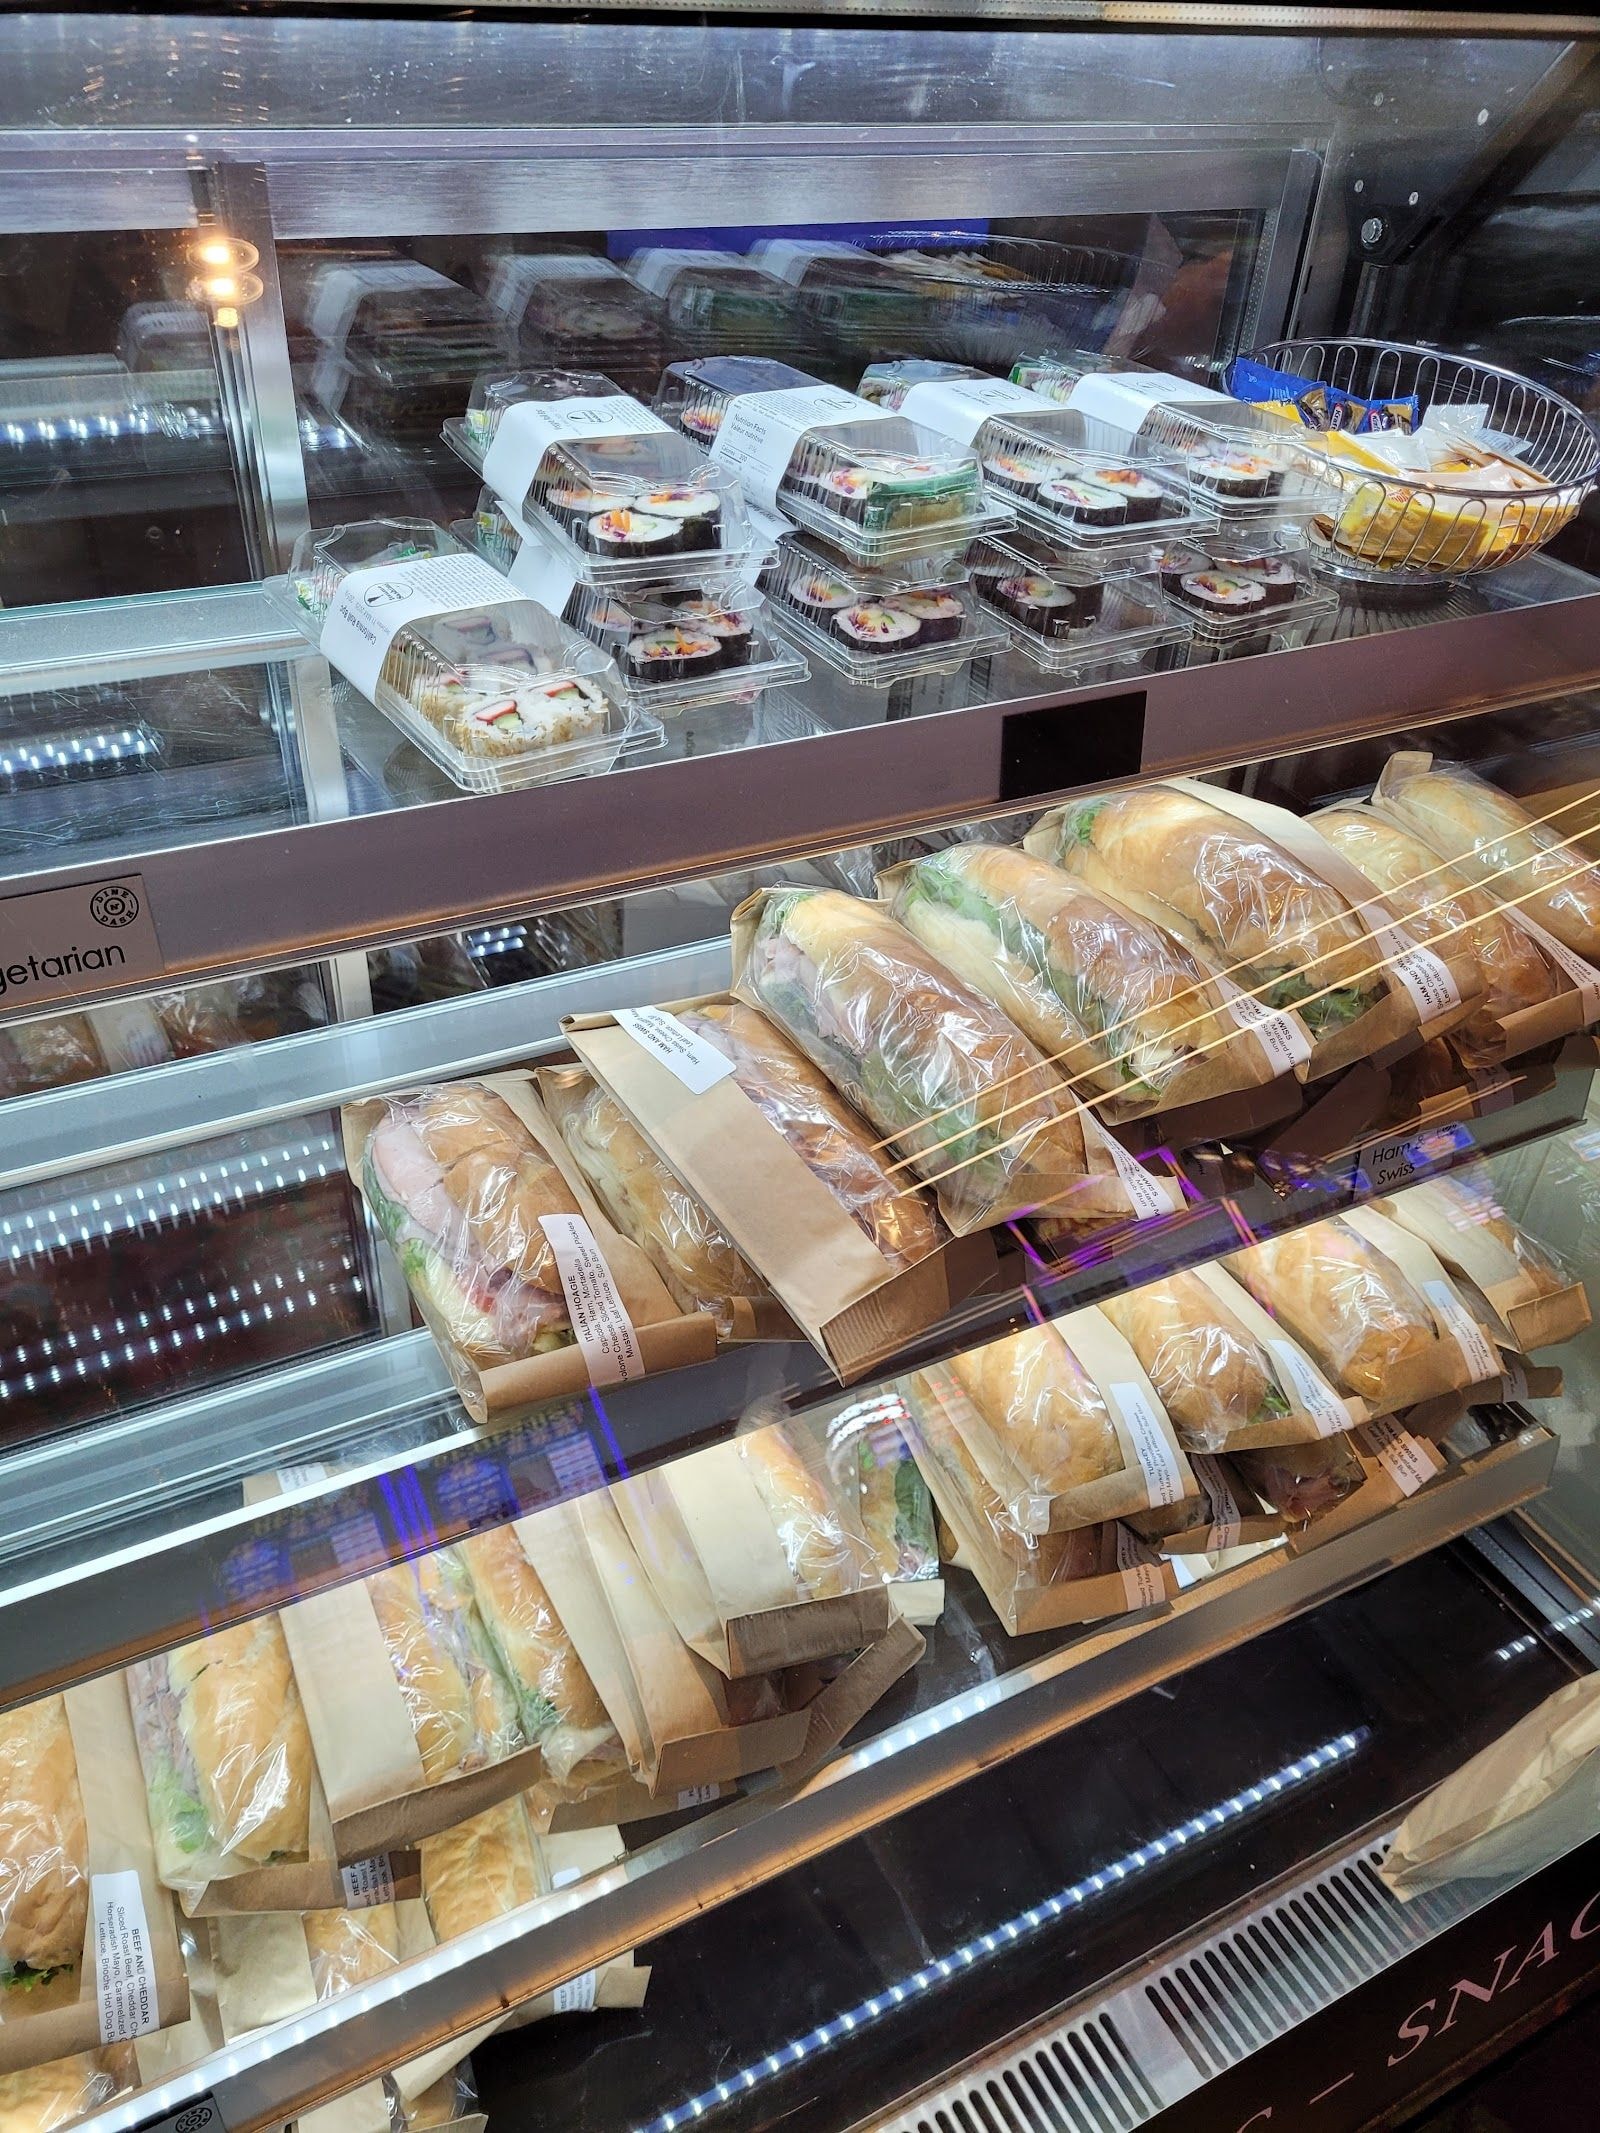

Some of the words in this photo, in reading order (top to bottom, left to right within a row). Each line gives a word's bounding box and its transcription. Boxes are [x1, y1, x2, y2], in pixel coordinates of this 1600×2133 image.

[353, 619, 378, 645] California
[95, 889, 129, 904] DINE
[100, 910, 134, 925] DASH
[1409, 970, 1421, 985] AND
[1420, 987, 1433, 1005] HAM
[1434, 988, 1443, 1010] Swiss
[1440, 987, 1450, 1004] Leaf
[1261, 1023, 1272, 1037] Sub
[1270, 1038, 1280, 1053] Bun
[1270, 1023, 1289, 1052] Mustard
[1274, 1017, 1293, 1041] SWISS
[1372, 1142, 1411, 1165] Ham
[1377, 1162, 1415, 1185] Swiss
[1135, 1179, 1156, 1207] Mustard
[1139, 1174, 1158, 1197] SWISS
[1136, 1192, 1147, 1207] Bun
[580, 1246, 591, 1268] Sweet
[590, 1248, 599, 1262] Bun
[568, 1275, 584, 1311] HOAGIE
[599, 1302, 610, 1323] Sliced
[579, 1311, 594, 1342] ITALIAN
[1141, 1448, 1155, 1477] TURKEY
[1397, 1452, 1416, 1474] Mustard
[1401, 1444, 1418, 1463] SWISS
[351, 1872, 360, 1896] BEEF
[107, 1901, 118, 1951] Horseradish
[116, 1907, 127, 1930] Sliced
[99, 1922, 107, 1956] Lettuce,
[121, 1932, 131, 1958] Roast
[131, 1928, 142, 1952] BEEF
[101, 1958, 110, 1992] Brioche
[112, 1952, 121, 1979] Mayo,
[124, 1959, 134, 1981] Beef,
[135, 1954, 145, 1975] AND
[104, 1992, 112, 2010] Hot
[114, 1980, 127, 2036] Caramelized
[126, 1982, 136, 2020] Cheddar
[138, 1977, 149, 2025] CHEDDAR
[104, 2012, 114, 2029] Dog
